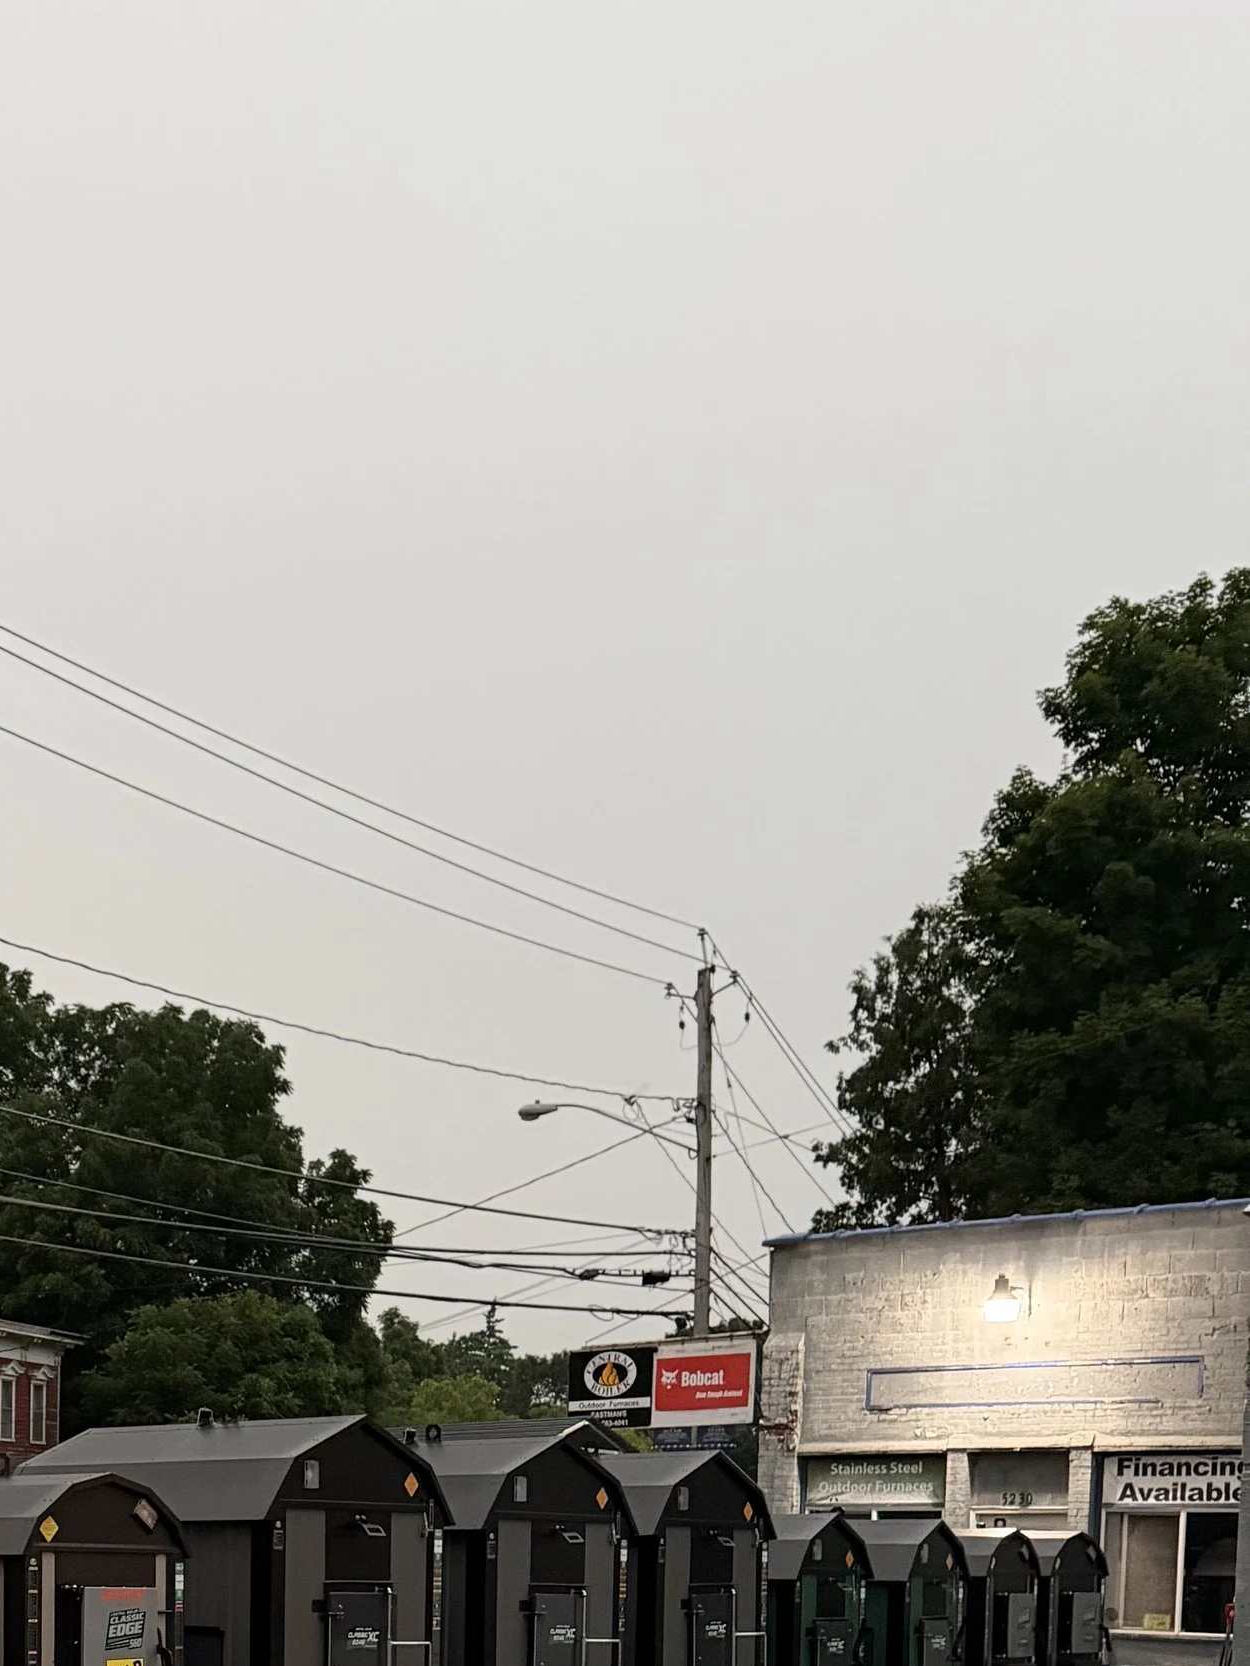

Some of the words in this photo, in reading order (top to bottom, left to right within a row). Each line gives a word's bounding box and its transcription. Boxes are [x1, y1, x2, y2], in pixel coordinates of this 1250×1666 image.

[586, 1353, 633, 1374] CENTRAL
[681, 1369, 724, 1387] Bobcat
[591, 1380, 631, 1396] BOILER
[608, 1400, 640, 1408] Furnaces
[830, 1461, 888, 1476] Stainless
[889, 1460, 923, 1475] Steel
[818, 1480, 872, 1493] Outdoor
[874, 1480, 934, 1494] Furnaces
[1002, 1492, 1033, 1506] 5230
[110, 1612, 145, 1624] CLASSIC
[108, 1621, 143, 1638] EDGE
